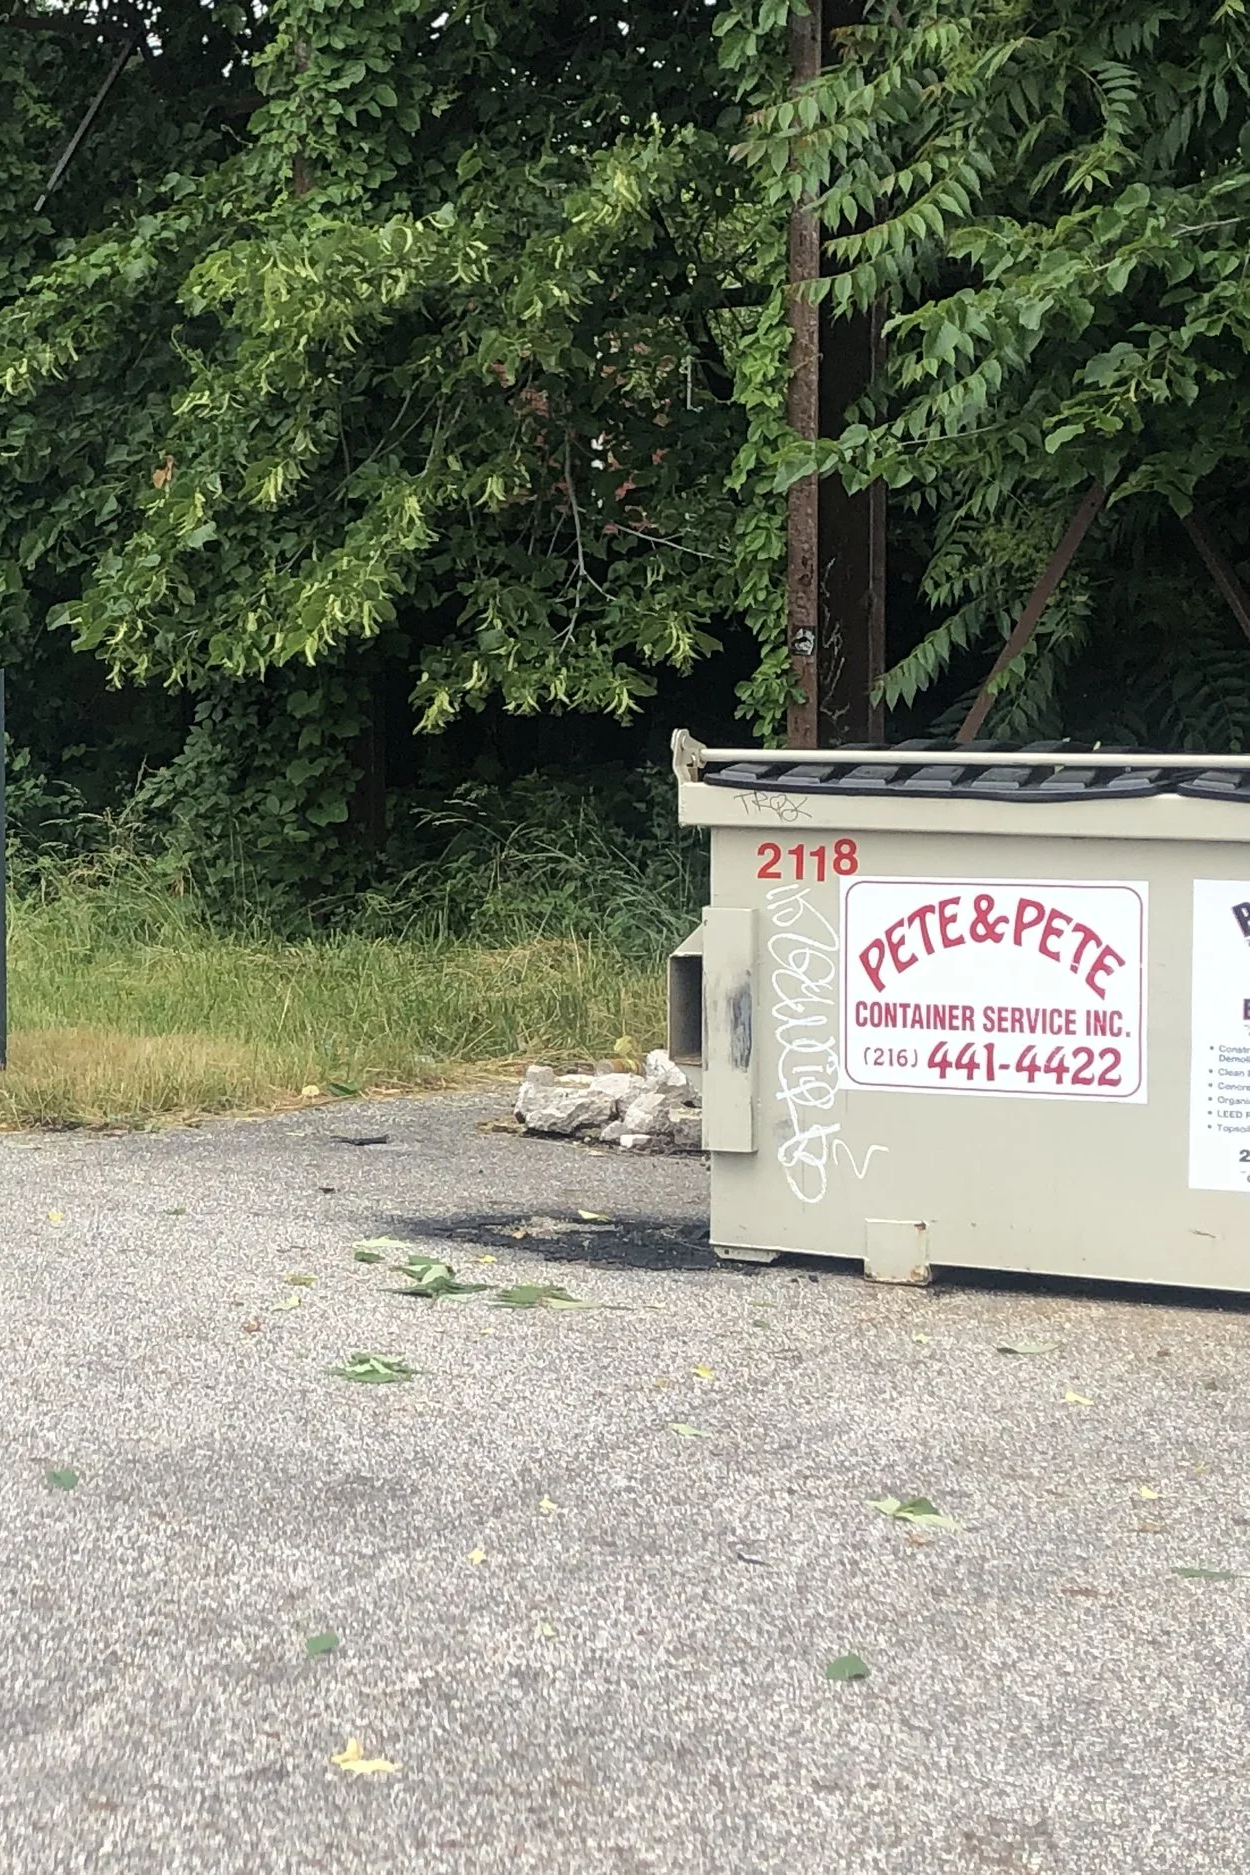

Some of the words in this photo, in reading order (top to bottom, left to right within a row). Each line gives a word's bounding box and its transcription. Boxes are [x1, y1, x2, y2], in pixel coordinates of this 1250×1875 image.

[757, 838, 858, 882] 2118
[855, 1000, 975, 1031] CONTAINER
[982, 1006, 1077, 1036] SERVICE
[1085, 1010, 1131, 1038] INC.
[864, 1047, 918, 1068] (216)
[927, 1041, 1122, 1087] 441-4422
